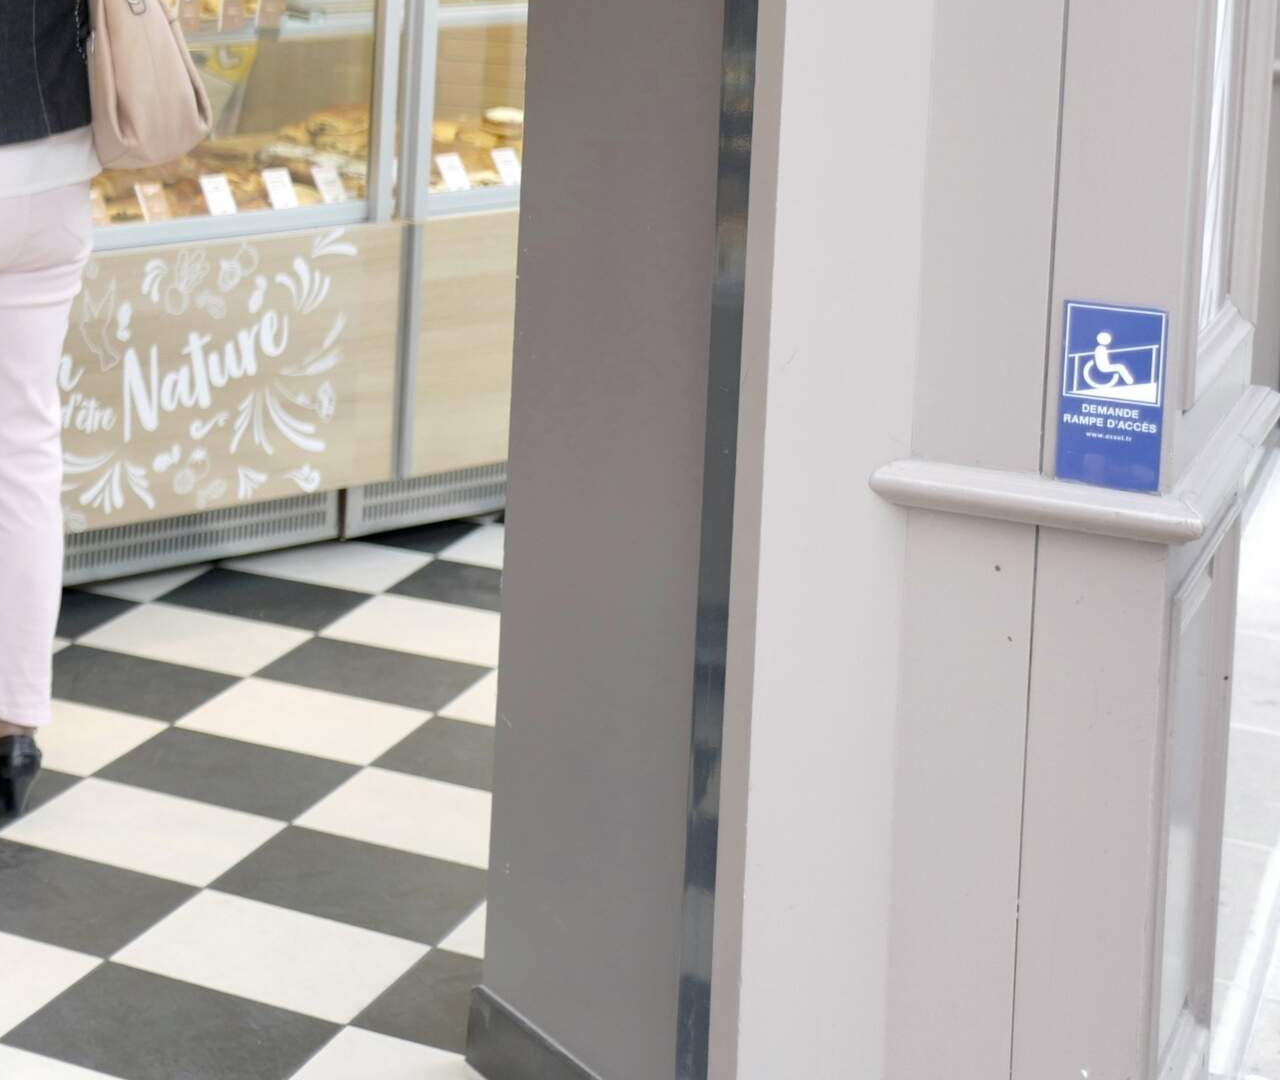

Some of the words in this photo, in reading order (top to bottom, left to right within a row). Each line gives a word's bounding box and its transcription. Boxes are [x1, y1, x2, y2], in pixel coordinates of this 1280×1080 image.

[122, 310, 290, 444] Nature
[1081, 403, 1140, 419] DEMANDE
[1063, 413, 1104, 428] RAMPE
[1107, 418, 1158, 434] D'ACCÈS
